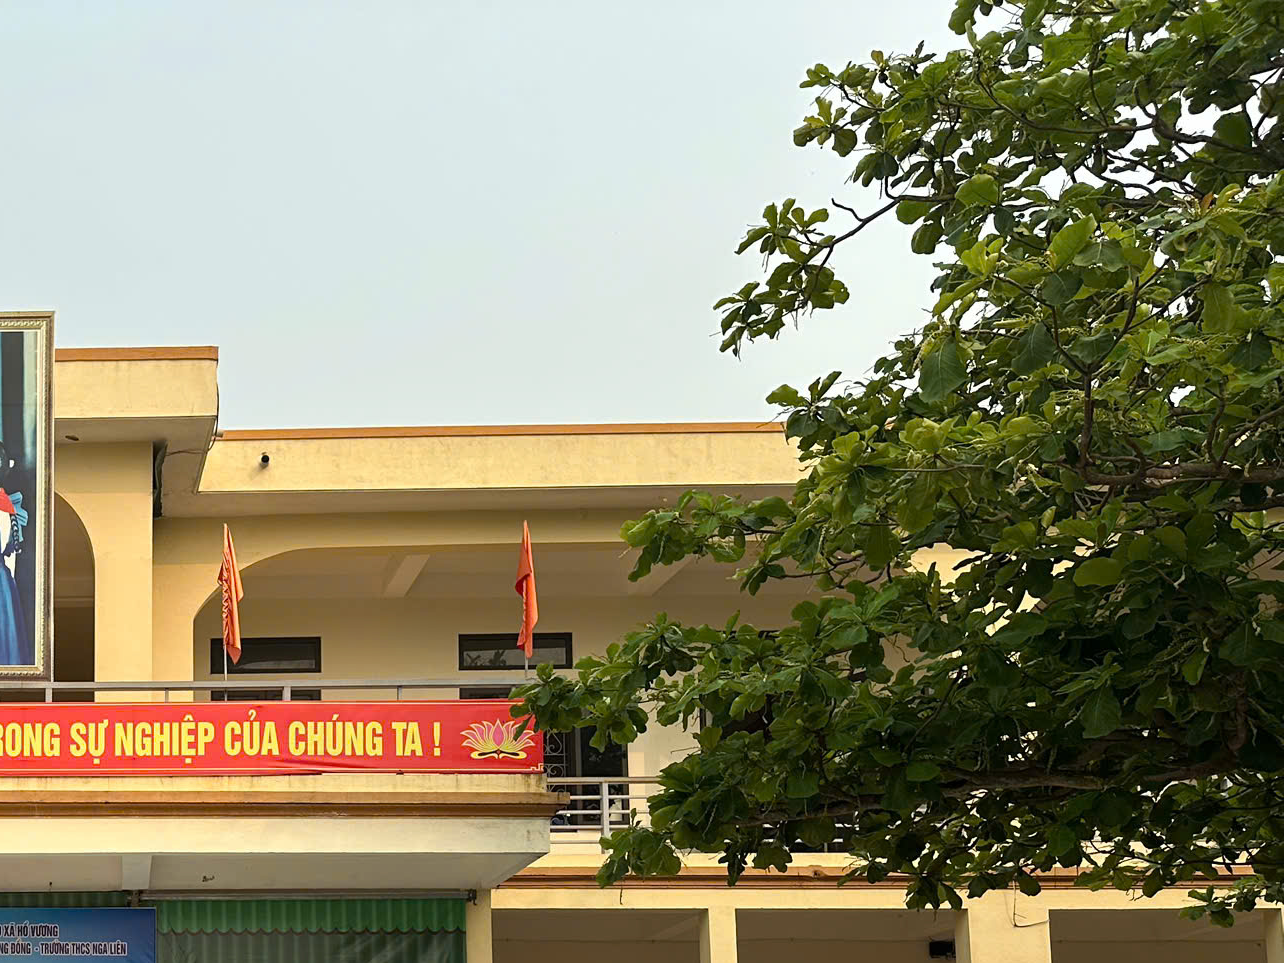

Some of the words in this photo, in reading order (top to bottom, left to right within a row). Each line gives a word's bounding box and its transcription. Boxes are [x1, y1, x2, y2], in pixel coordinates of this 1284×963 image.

[70, 719, 108, 764] SỰ
[119, 715, 214, 763] NGHIỆP
[225, 710, 279, 756] CỦA
[289, 714, 382, 756] CHÚNG
[392, 722, 423, 756] TA
[434, 722, 440, 756] !
